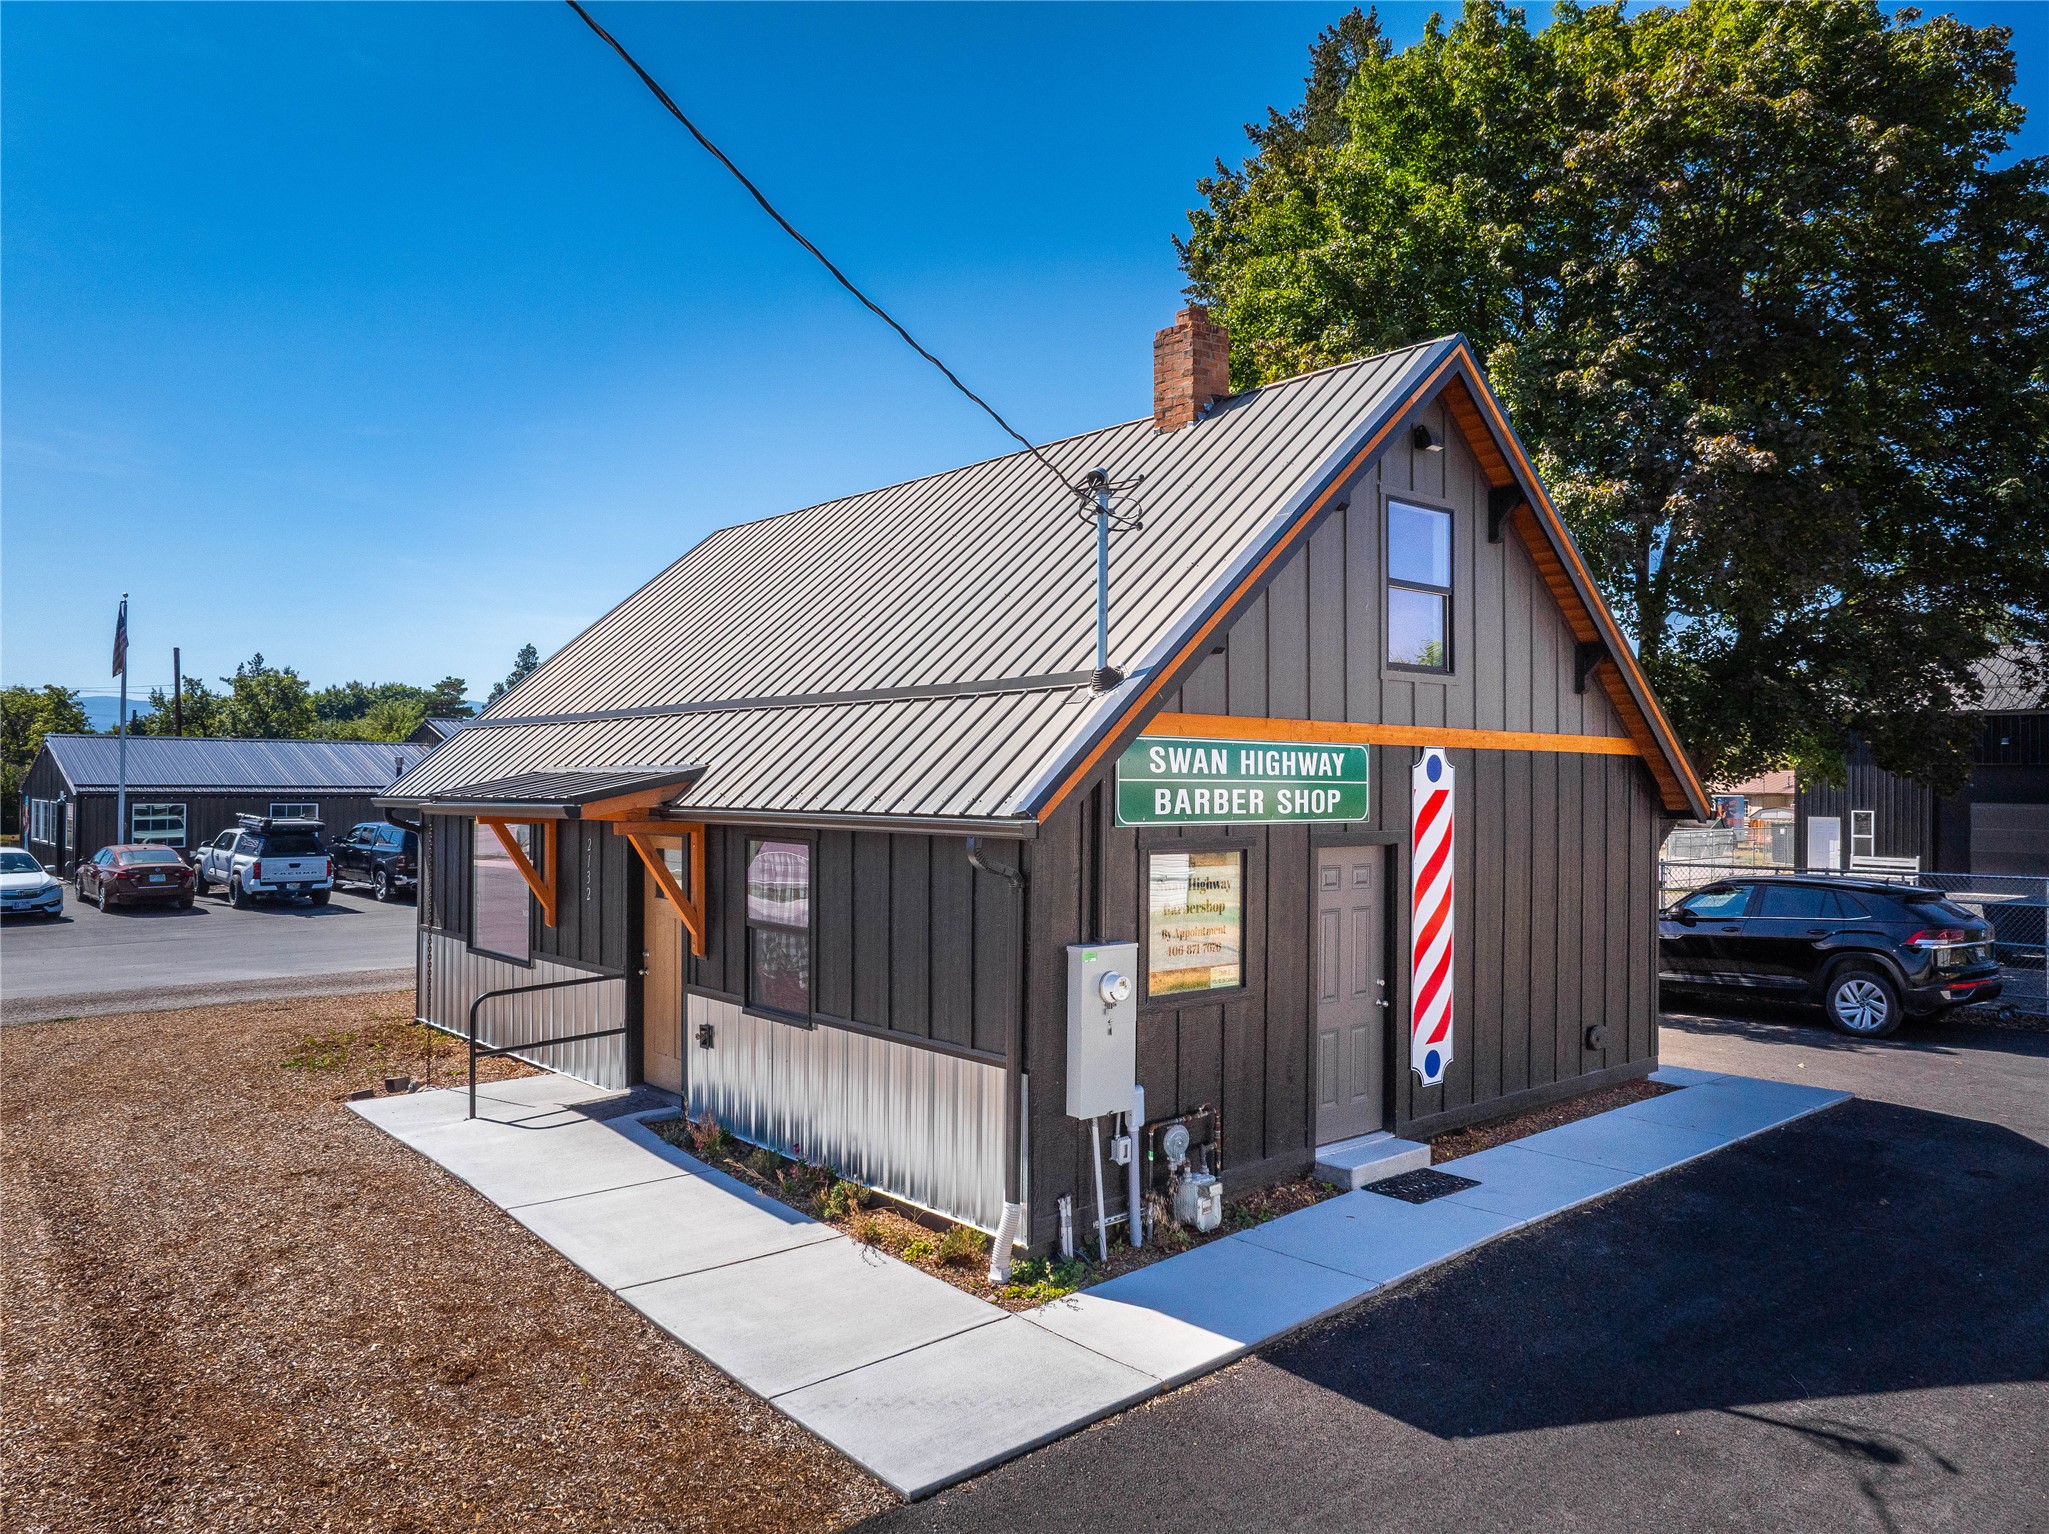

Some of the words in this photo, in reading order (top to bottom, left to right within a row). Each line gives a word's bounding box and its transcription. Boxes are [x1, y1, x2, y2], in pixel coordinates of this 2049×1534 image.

[1149, 746, 1228, 775] SWAN
[1240, 749, 1346, 777] HIGHWAY
[1154, 788, 1265, 816] BARBER
[1276, 788, 1342, 815] SHOP
[1188, 876, 1231, 895] Highway
[1160, 929, 1171, 942] By
[1172, 925, 1227, 941] Appointment
